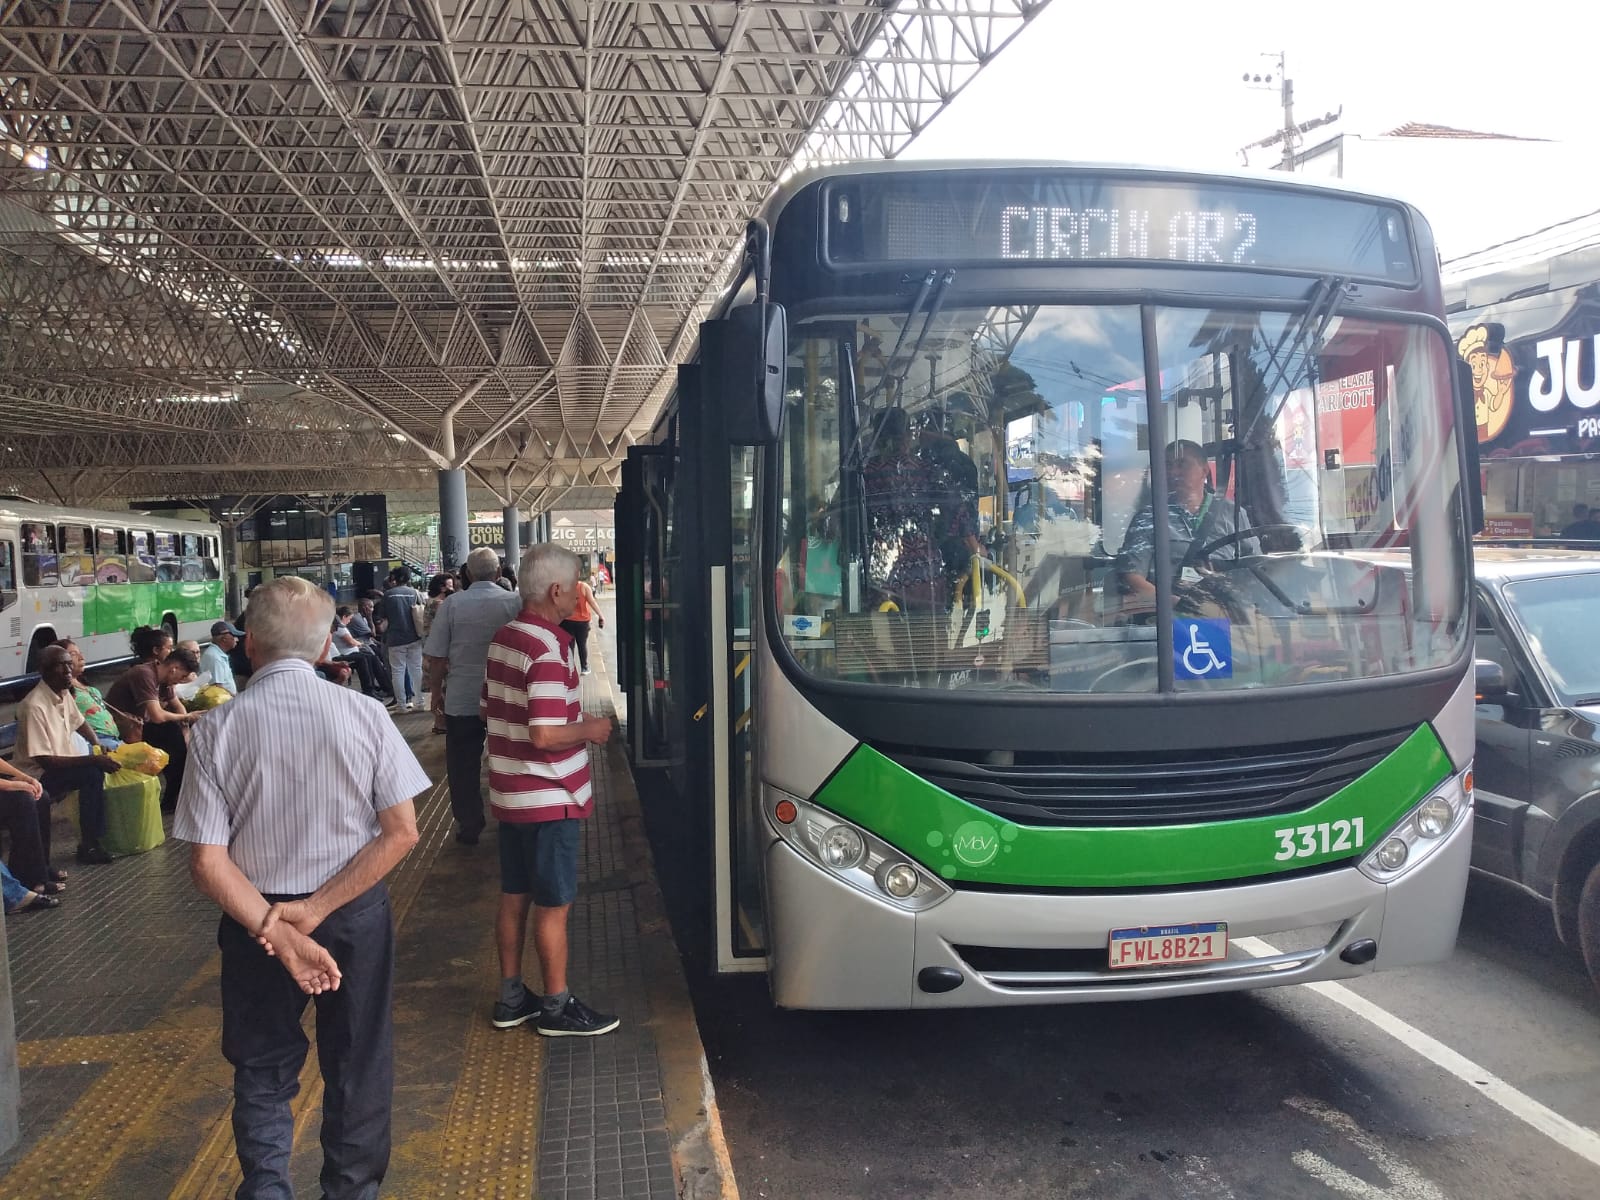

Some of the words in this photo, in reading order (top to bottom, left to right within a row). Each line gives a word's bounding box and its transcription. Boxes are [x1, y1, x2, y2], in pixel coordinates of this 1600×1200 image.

[551, 528, 577, 540] ZIG
[584, 528, 615, 540] ZAG
[1274, 816, 1364, 861] 33121
[1160, 927, 1180, 936] BRASIL
[1120, 935, 1213, 963] FWL8B21
